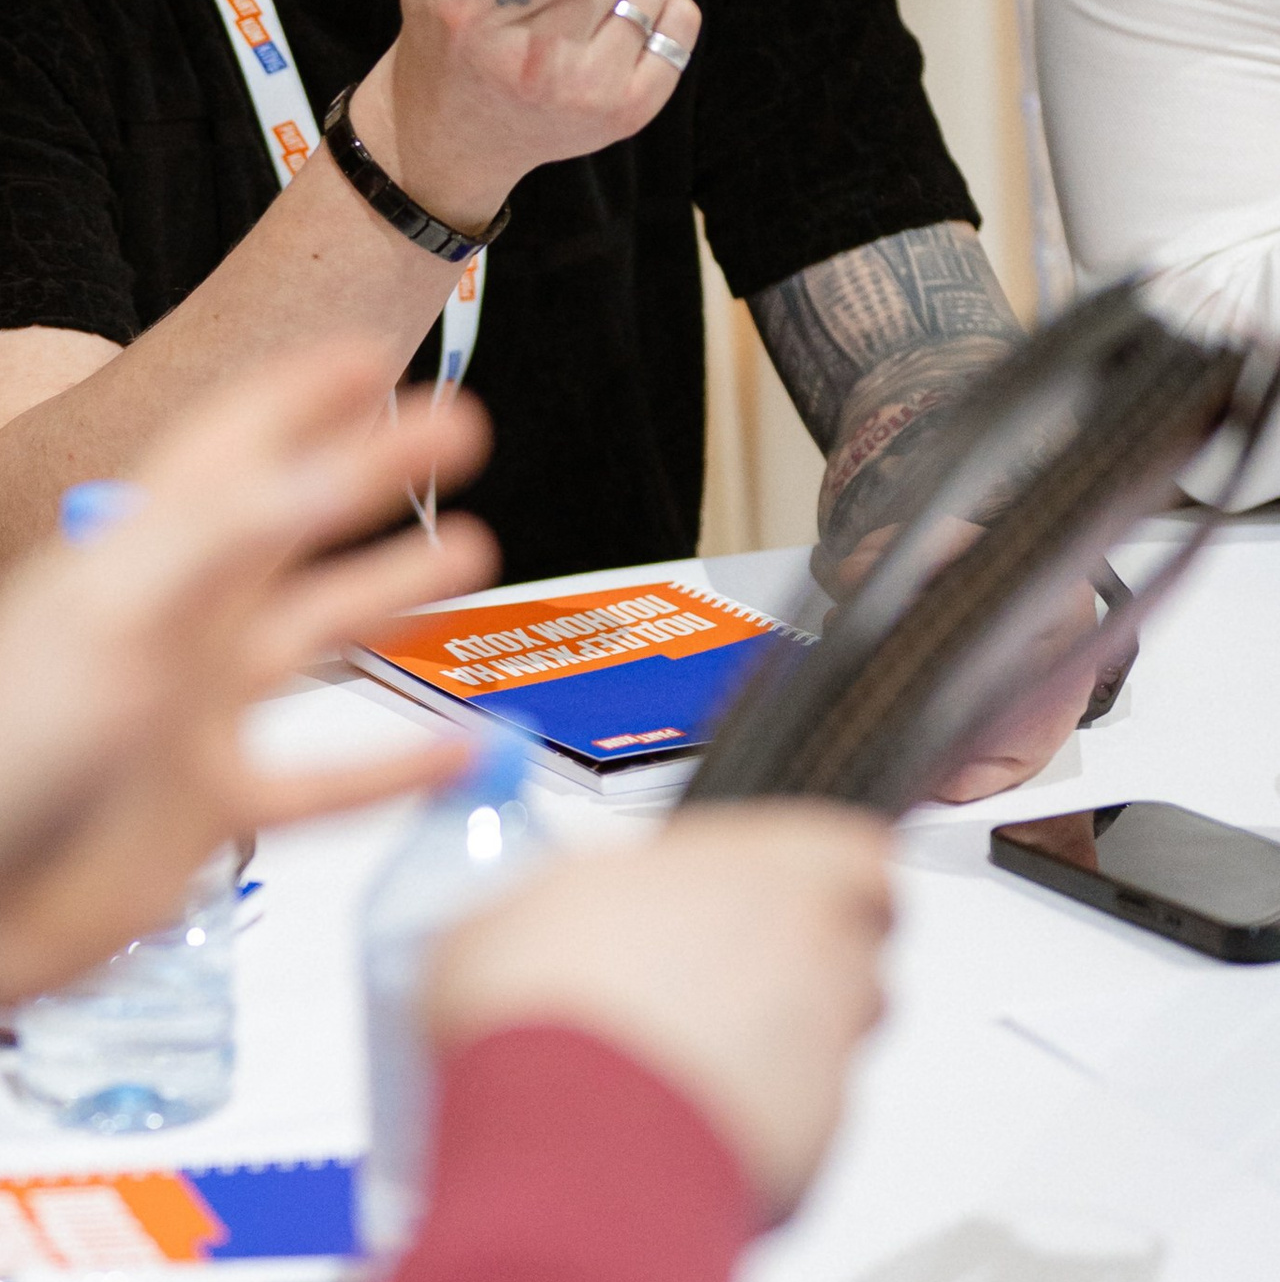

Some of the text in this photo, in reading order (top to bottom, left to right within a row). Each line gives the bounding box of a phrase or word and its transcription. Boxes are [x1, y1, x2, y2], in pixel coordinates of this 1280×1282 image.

[439, 611, 718, 686] ПОДДЕРЖИМ НА
[443, 594, 681, 663] ПОЛНОМ ХОДУ
